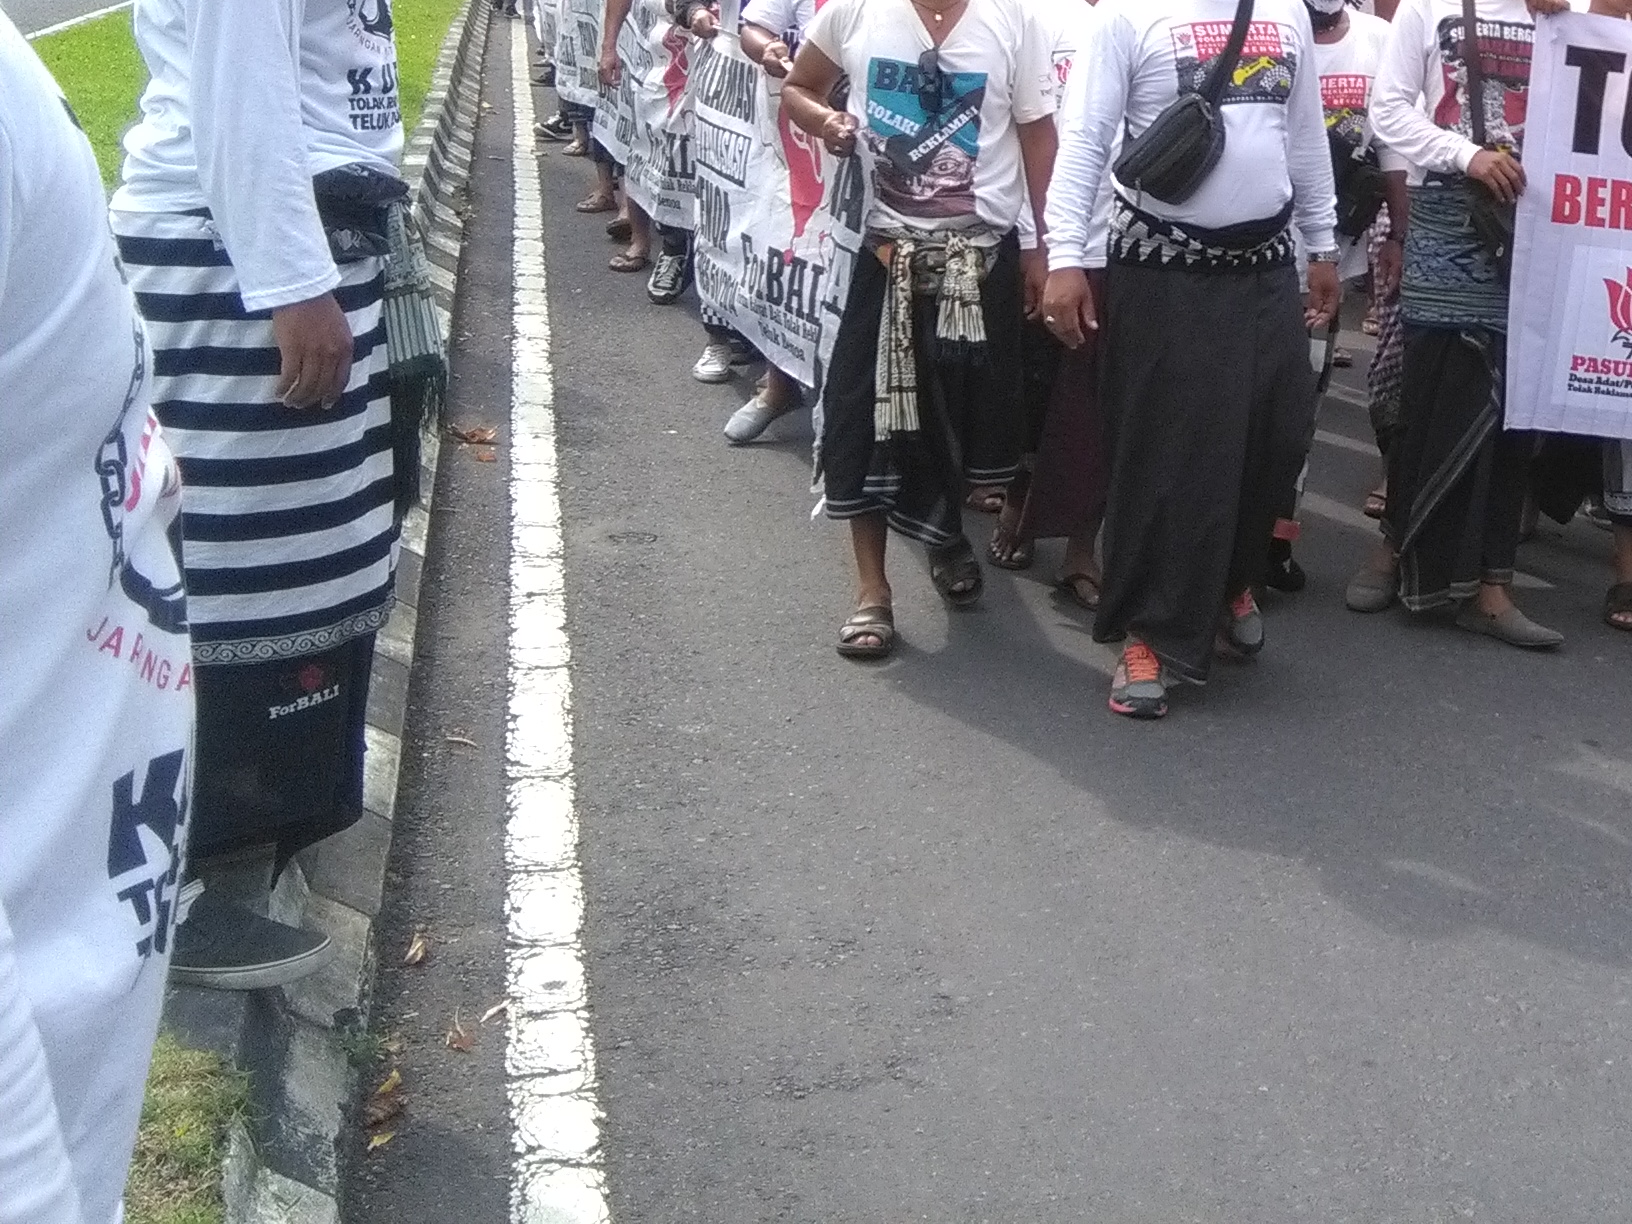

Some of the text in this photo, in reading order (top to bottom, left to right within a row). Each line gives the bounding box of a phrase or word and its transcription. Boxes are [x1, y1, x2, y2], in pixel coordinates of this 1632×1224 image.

[867, 99, 921, 137] TOLAK!
[1567, 382, 1593, 395] Tolak
[1568, 373, 1594, 385] Desa
[268, 684, 340, 720] ForBALI
